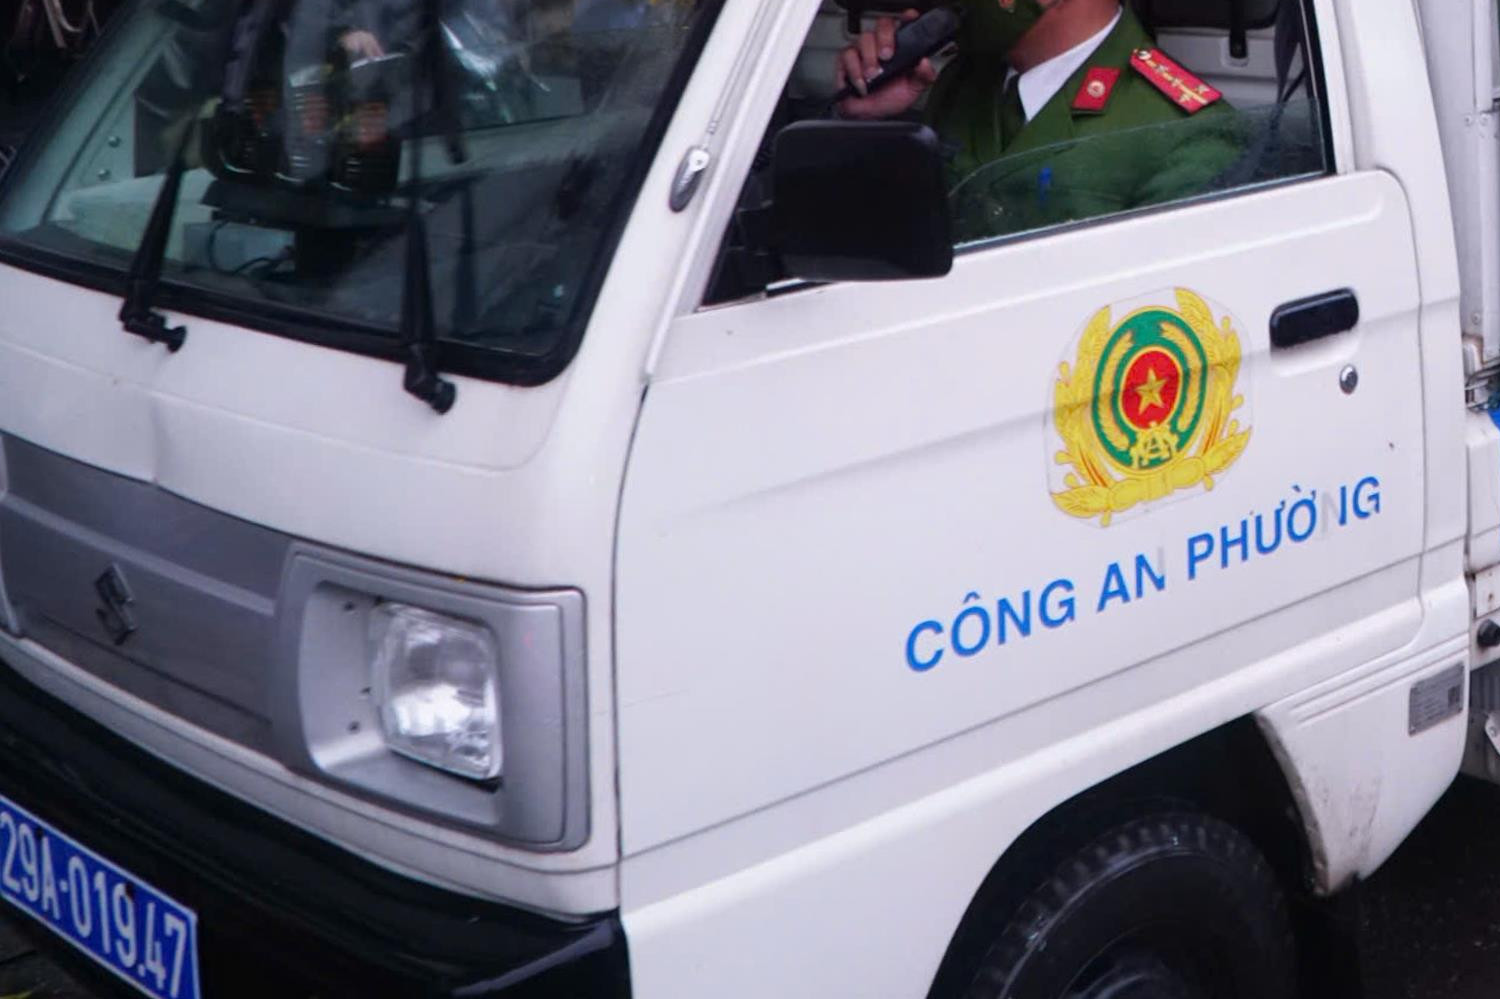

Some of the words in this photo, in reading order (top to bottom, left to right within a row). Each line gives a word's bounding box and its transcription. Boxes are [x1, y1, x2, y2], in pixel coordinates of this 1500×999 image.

[904, 577, 1076, 672] CÔNG
[1096, 552, 1167, 613] AN
[1186, 475, 1383, 581] PHƯỜNG
[0, 811, 187, 998] 29A-019.47
